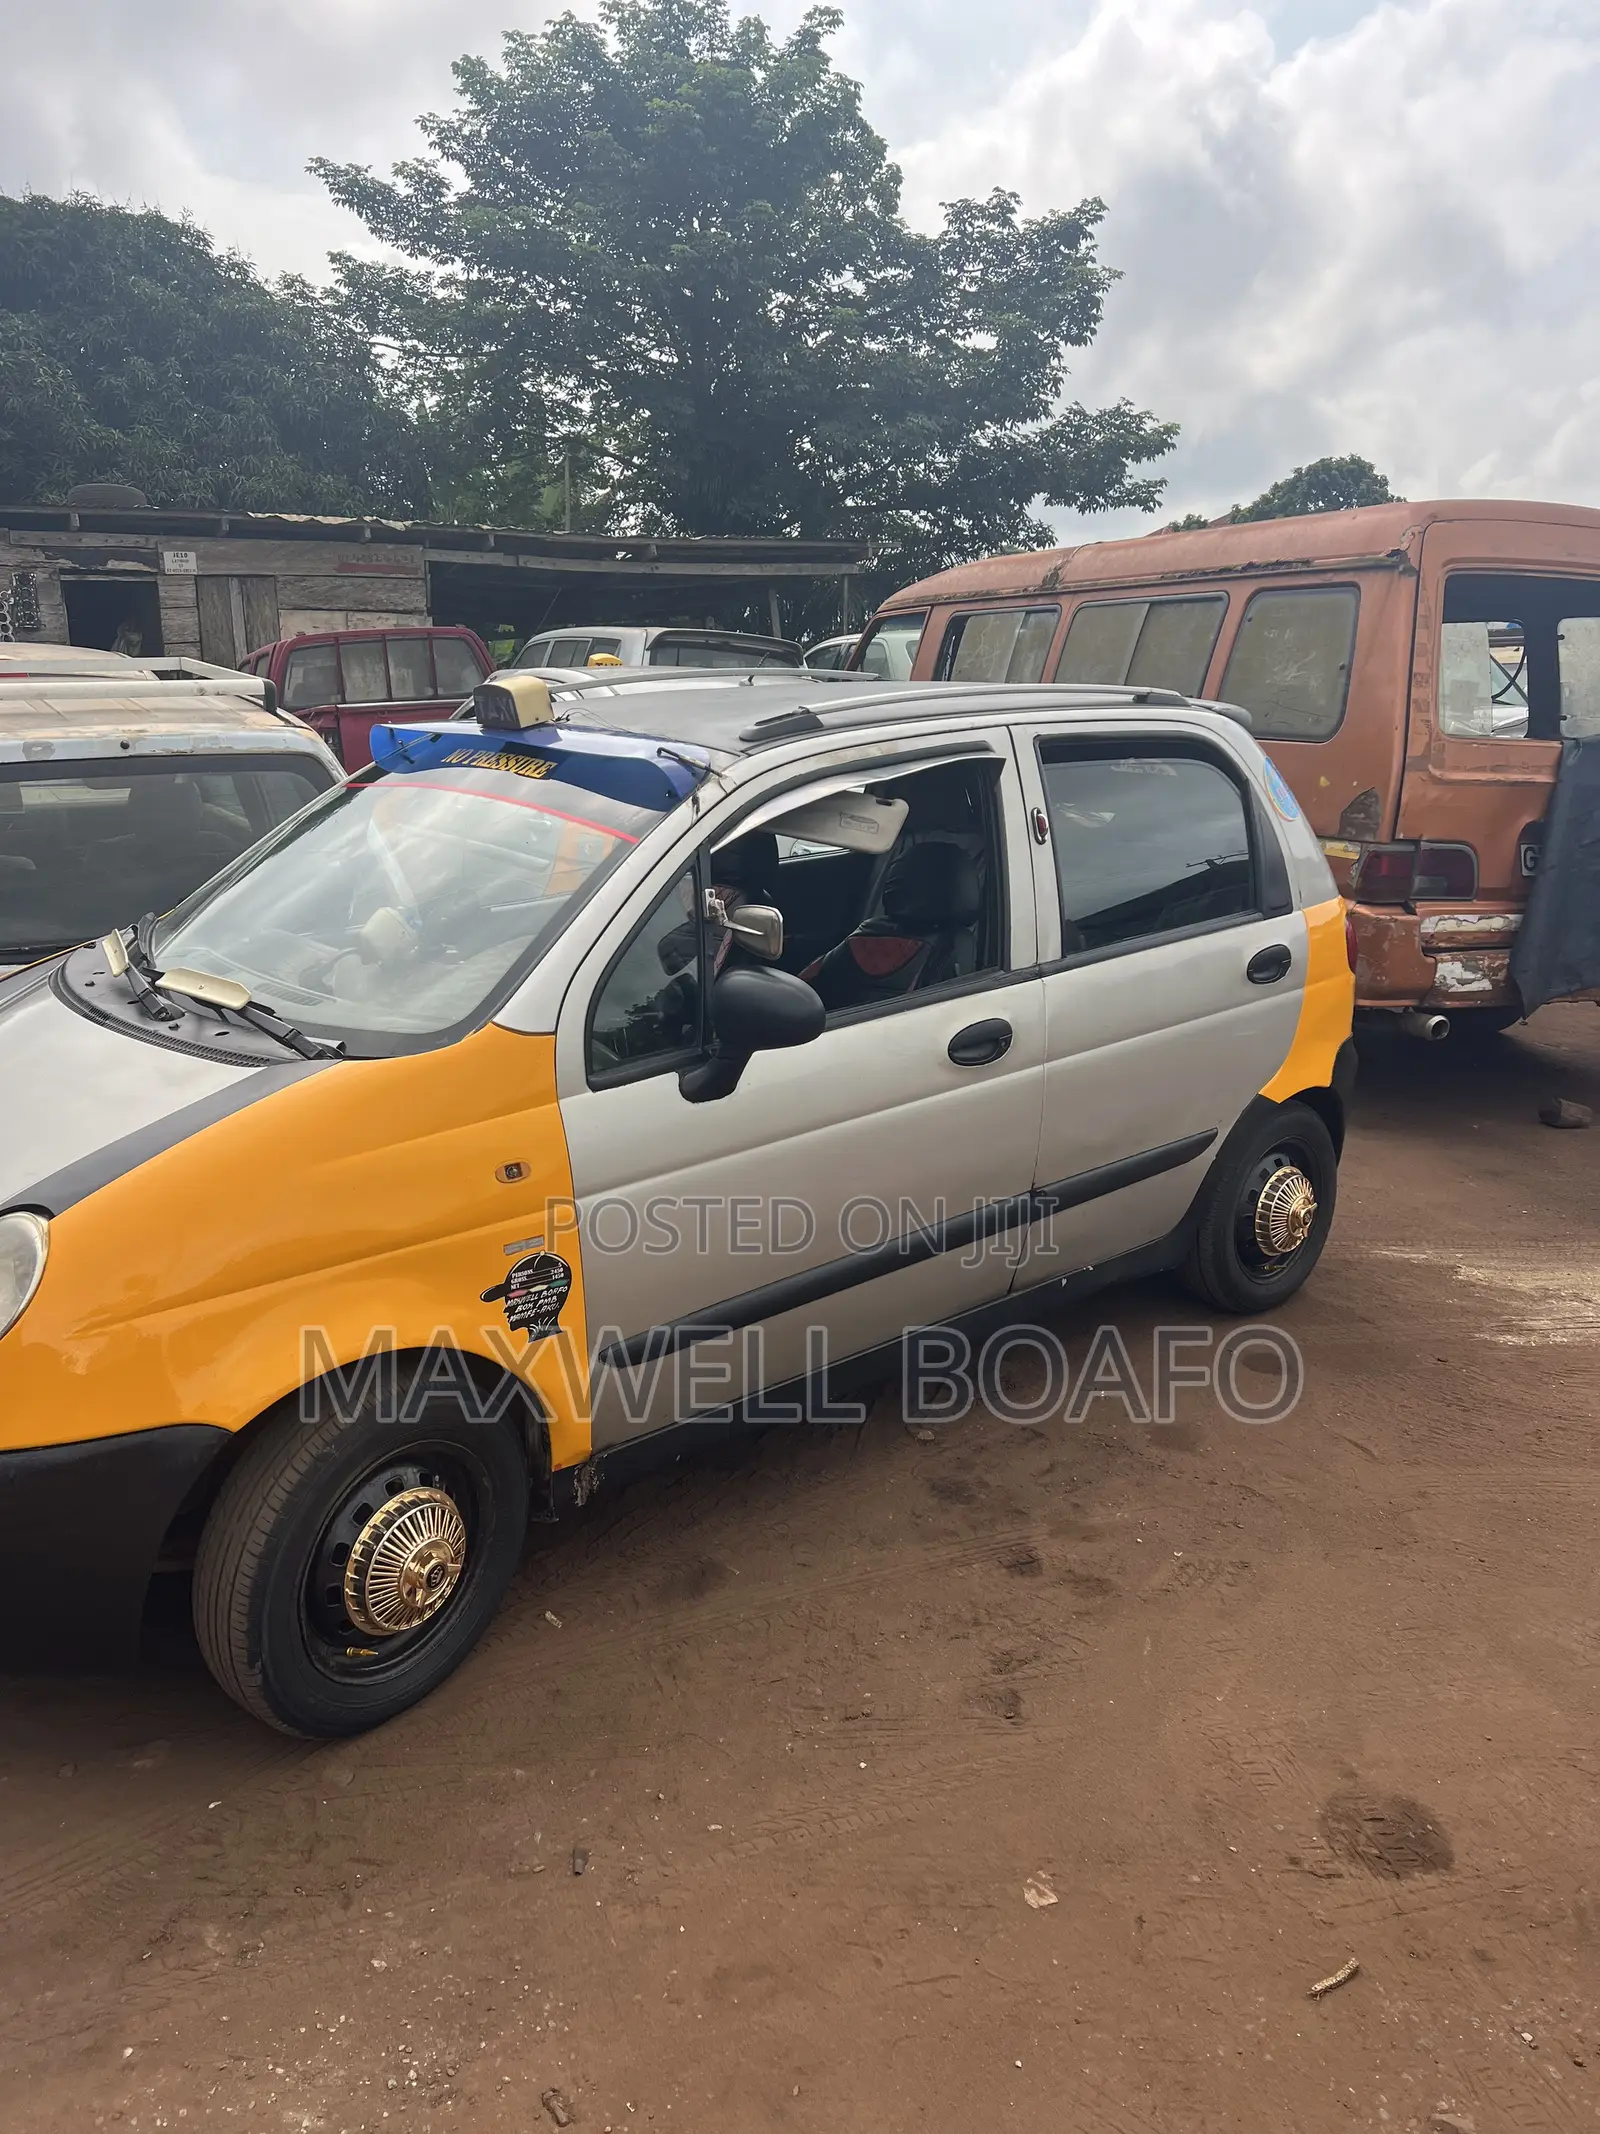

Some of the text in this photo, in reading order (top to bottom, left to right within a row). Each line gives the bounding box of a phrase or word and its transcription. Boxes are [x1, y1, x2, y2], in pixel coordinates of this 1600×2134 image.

[475, 696, 516, 722] TAXI
[442, 748, 558, 778] NO PRESSURE
[515, 1295, 557, 1313] BOX PMB
